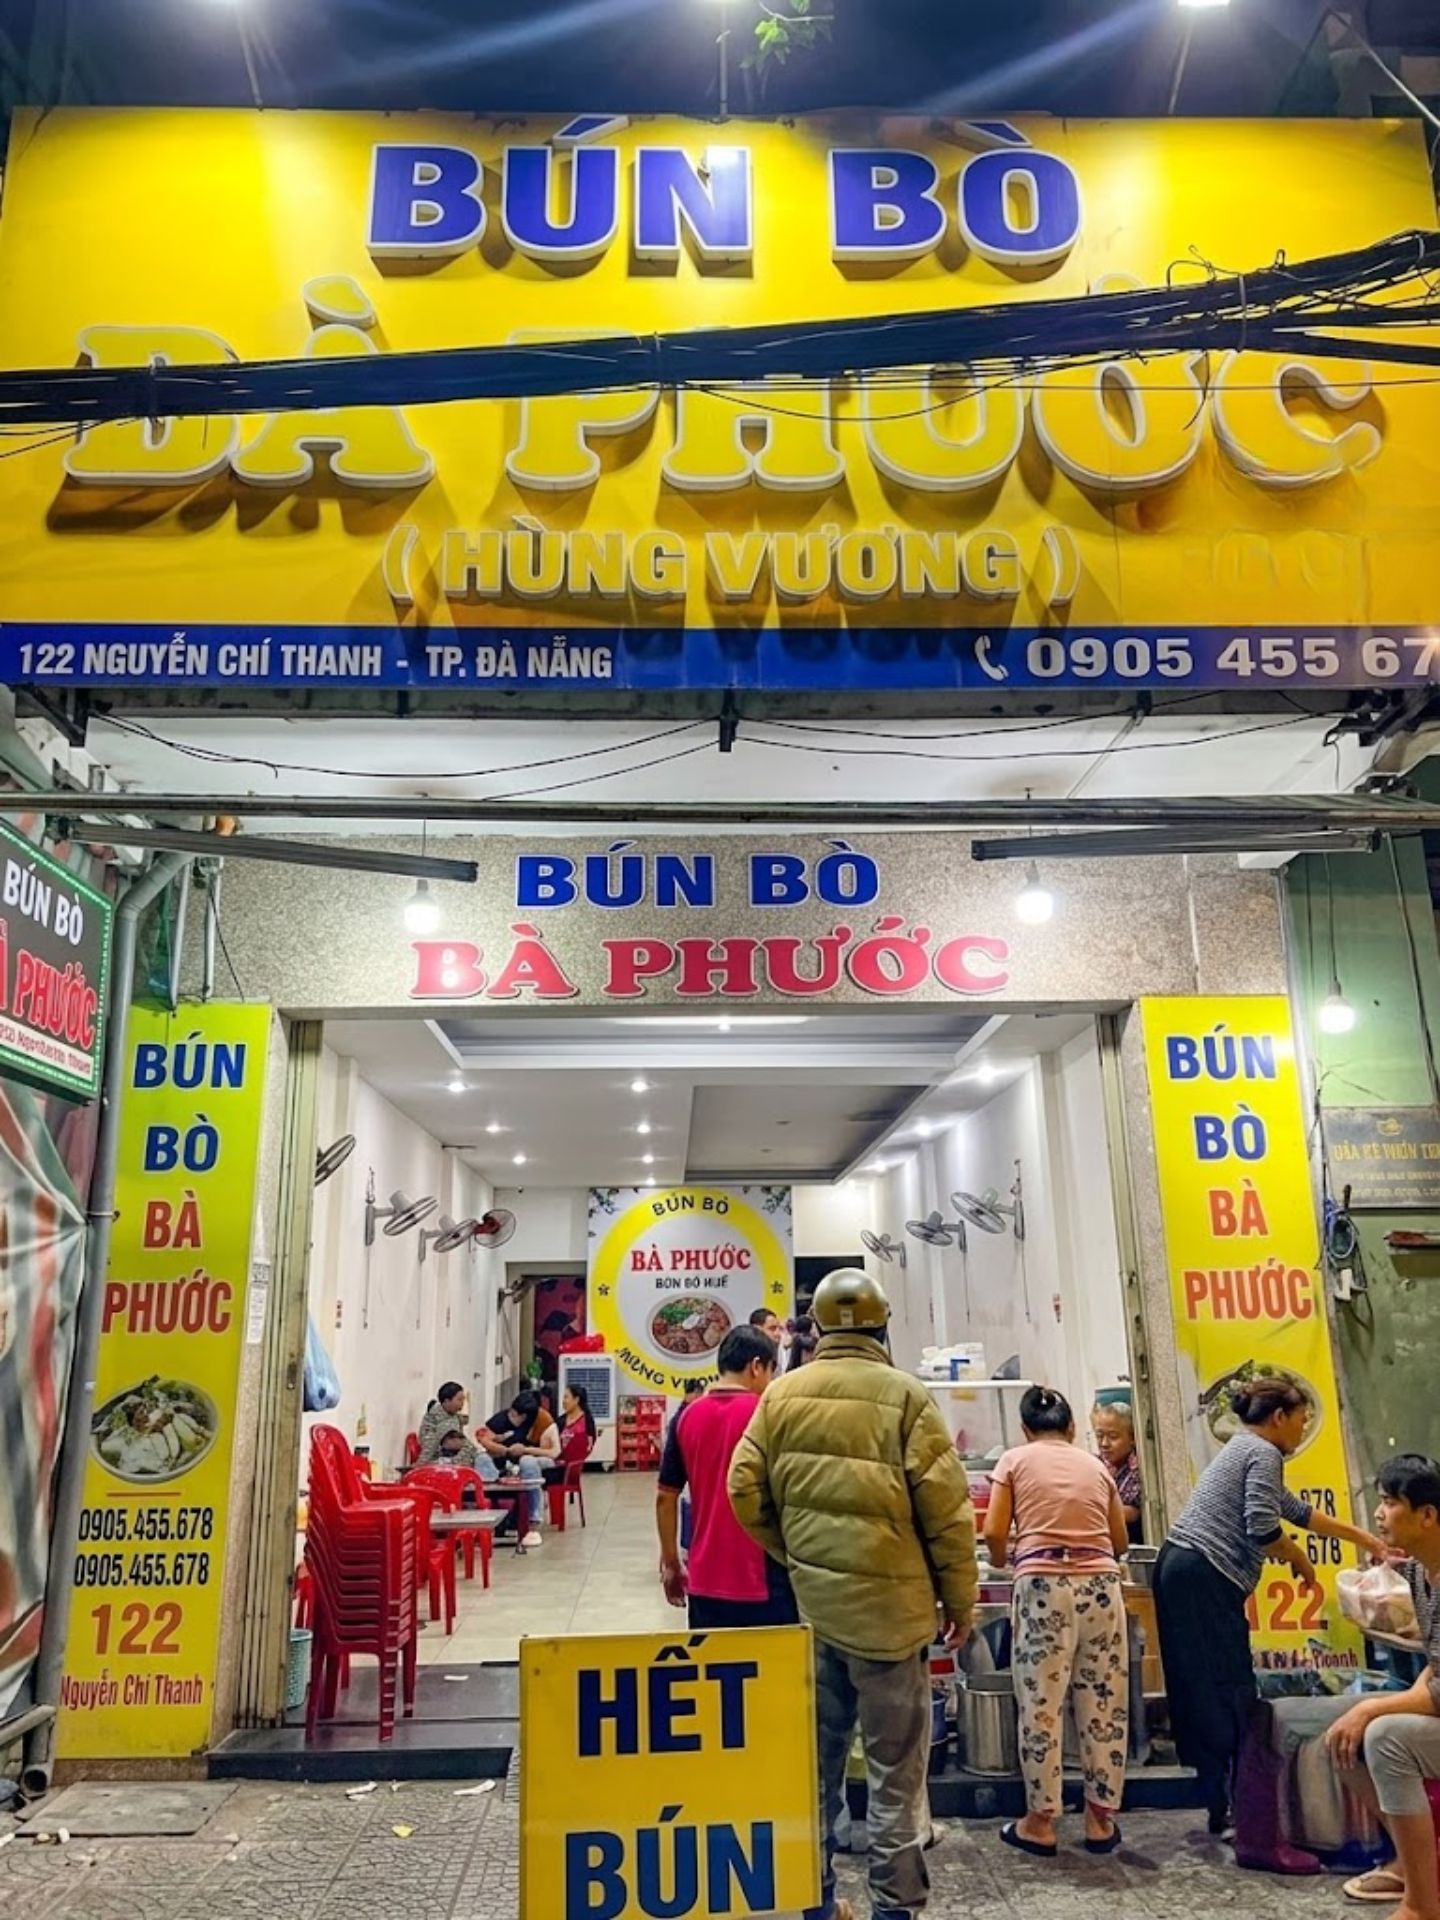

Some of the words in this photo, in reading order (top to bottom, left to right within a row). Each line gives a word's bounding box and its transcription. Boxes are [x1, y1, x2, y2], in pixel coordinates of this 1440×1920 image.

[366, 114, 753, 263] BÚN
[828, 120, 1080, 264] BÒ
[443, 514, 686, 599] HÙNG
[703, 524, 1021, 600] VƯƠNG
[20, 642, 75, 674] 122
[83, 631, 209, 676] NGUYỄN
[218, 637, 273, 676] CHÍ
[281, 645, 382, 677] THANH
[425, 646, 466, 678] TP.
[476, 639, 518, 678] ĐÀ
[527, 635, 613, 678] NẴNG
[1026, 636, 1194, 679] 0905
[1216, 636, 1340, 678] 455
[3, 858, 51, 928] BÚN
[54, 892, 84, 945] BÒ
[514, 840, 713, 908] BÚN
[749, 840, 880, 907] BÒ
[410, 921, 578, 998] BÀ
[601, 916, 1011, 996] PHƯỚC
[13, 948, 97, 1049] PHƯỚC
[133, 1031, 246, 1089] BÚN
[1166, 1024, 1276, 1080] BÚN
[144, 1113, 219, 1172] BÒ
[1194, 1104, 1266, 1161] BÒ
[143, 1189, 202, 1249] BÀ
[1209, 1179, 1268, 1237] BÀ
[631, 1243, 663, 1271] BÀ
[671, 1242, 751, 1270] PHƯỚC
[101, 1268, 232, 1334] PHƯỚC
[1184, 1257, 1312, 1320] PHƯỚC
[78, 1507, 213, 1541] 0905.455.678
[74, 1552, 209, 1587] 0905.455.678
[91, 1602, 183, 1655] 122
[61, 1668, 118, 1711] Nguyễn
[155, 1673, 203, 1705] Thanh
[578, 1634, 758, 1758] HẾT
[565, 1804, 775, 1920] BÚN
